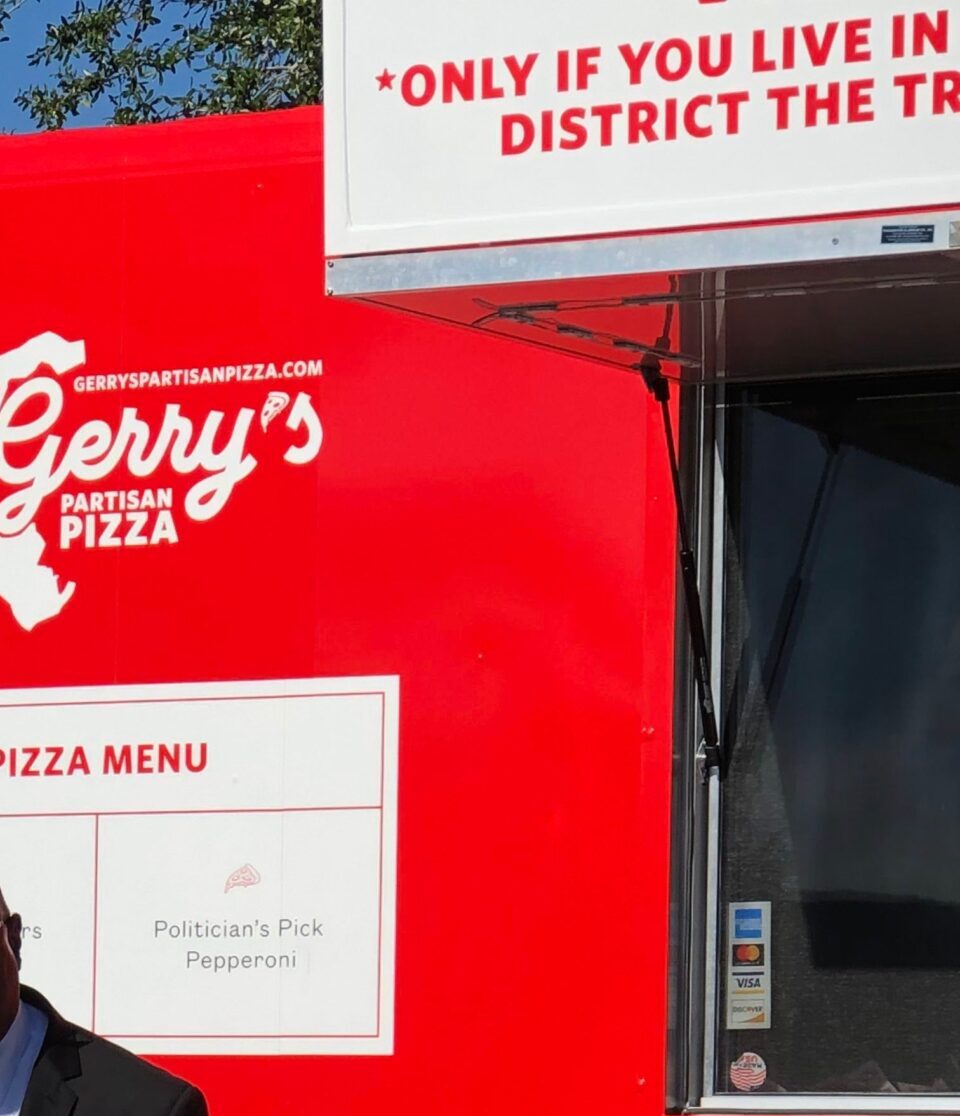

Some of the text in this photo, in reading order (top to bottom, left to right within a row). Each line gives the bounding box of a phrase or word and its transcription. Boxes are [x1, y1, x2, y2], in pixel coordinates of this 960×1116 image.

[556, 46, 602, 93] IF
[618, 32, 733, 86] YOU
[751, 18, 872, 74] LIVE
[891, 9, 949, 59] IN
[500, 90, 750, 157] DISTRICT
[766, 78, 875, 131] THE
[73, 359, 324, 393] GERRYSPARTISANPIZZA.COM
[60, 487, 173, 514] PARTISAN
[59, 509, 179, 550] PIZZA
[102, 742, 208, 775] MENU
[154, 918, 323, 938] Politician's Pick
[186, 950, 296, 973] Pepperoni
[735, 977, 761, 989] VISA
